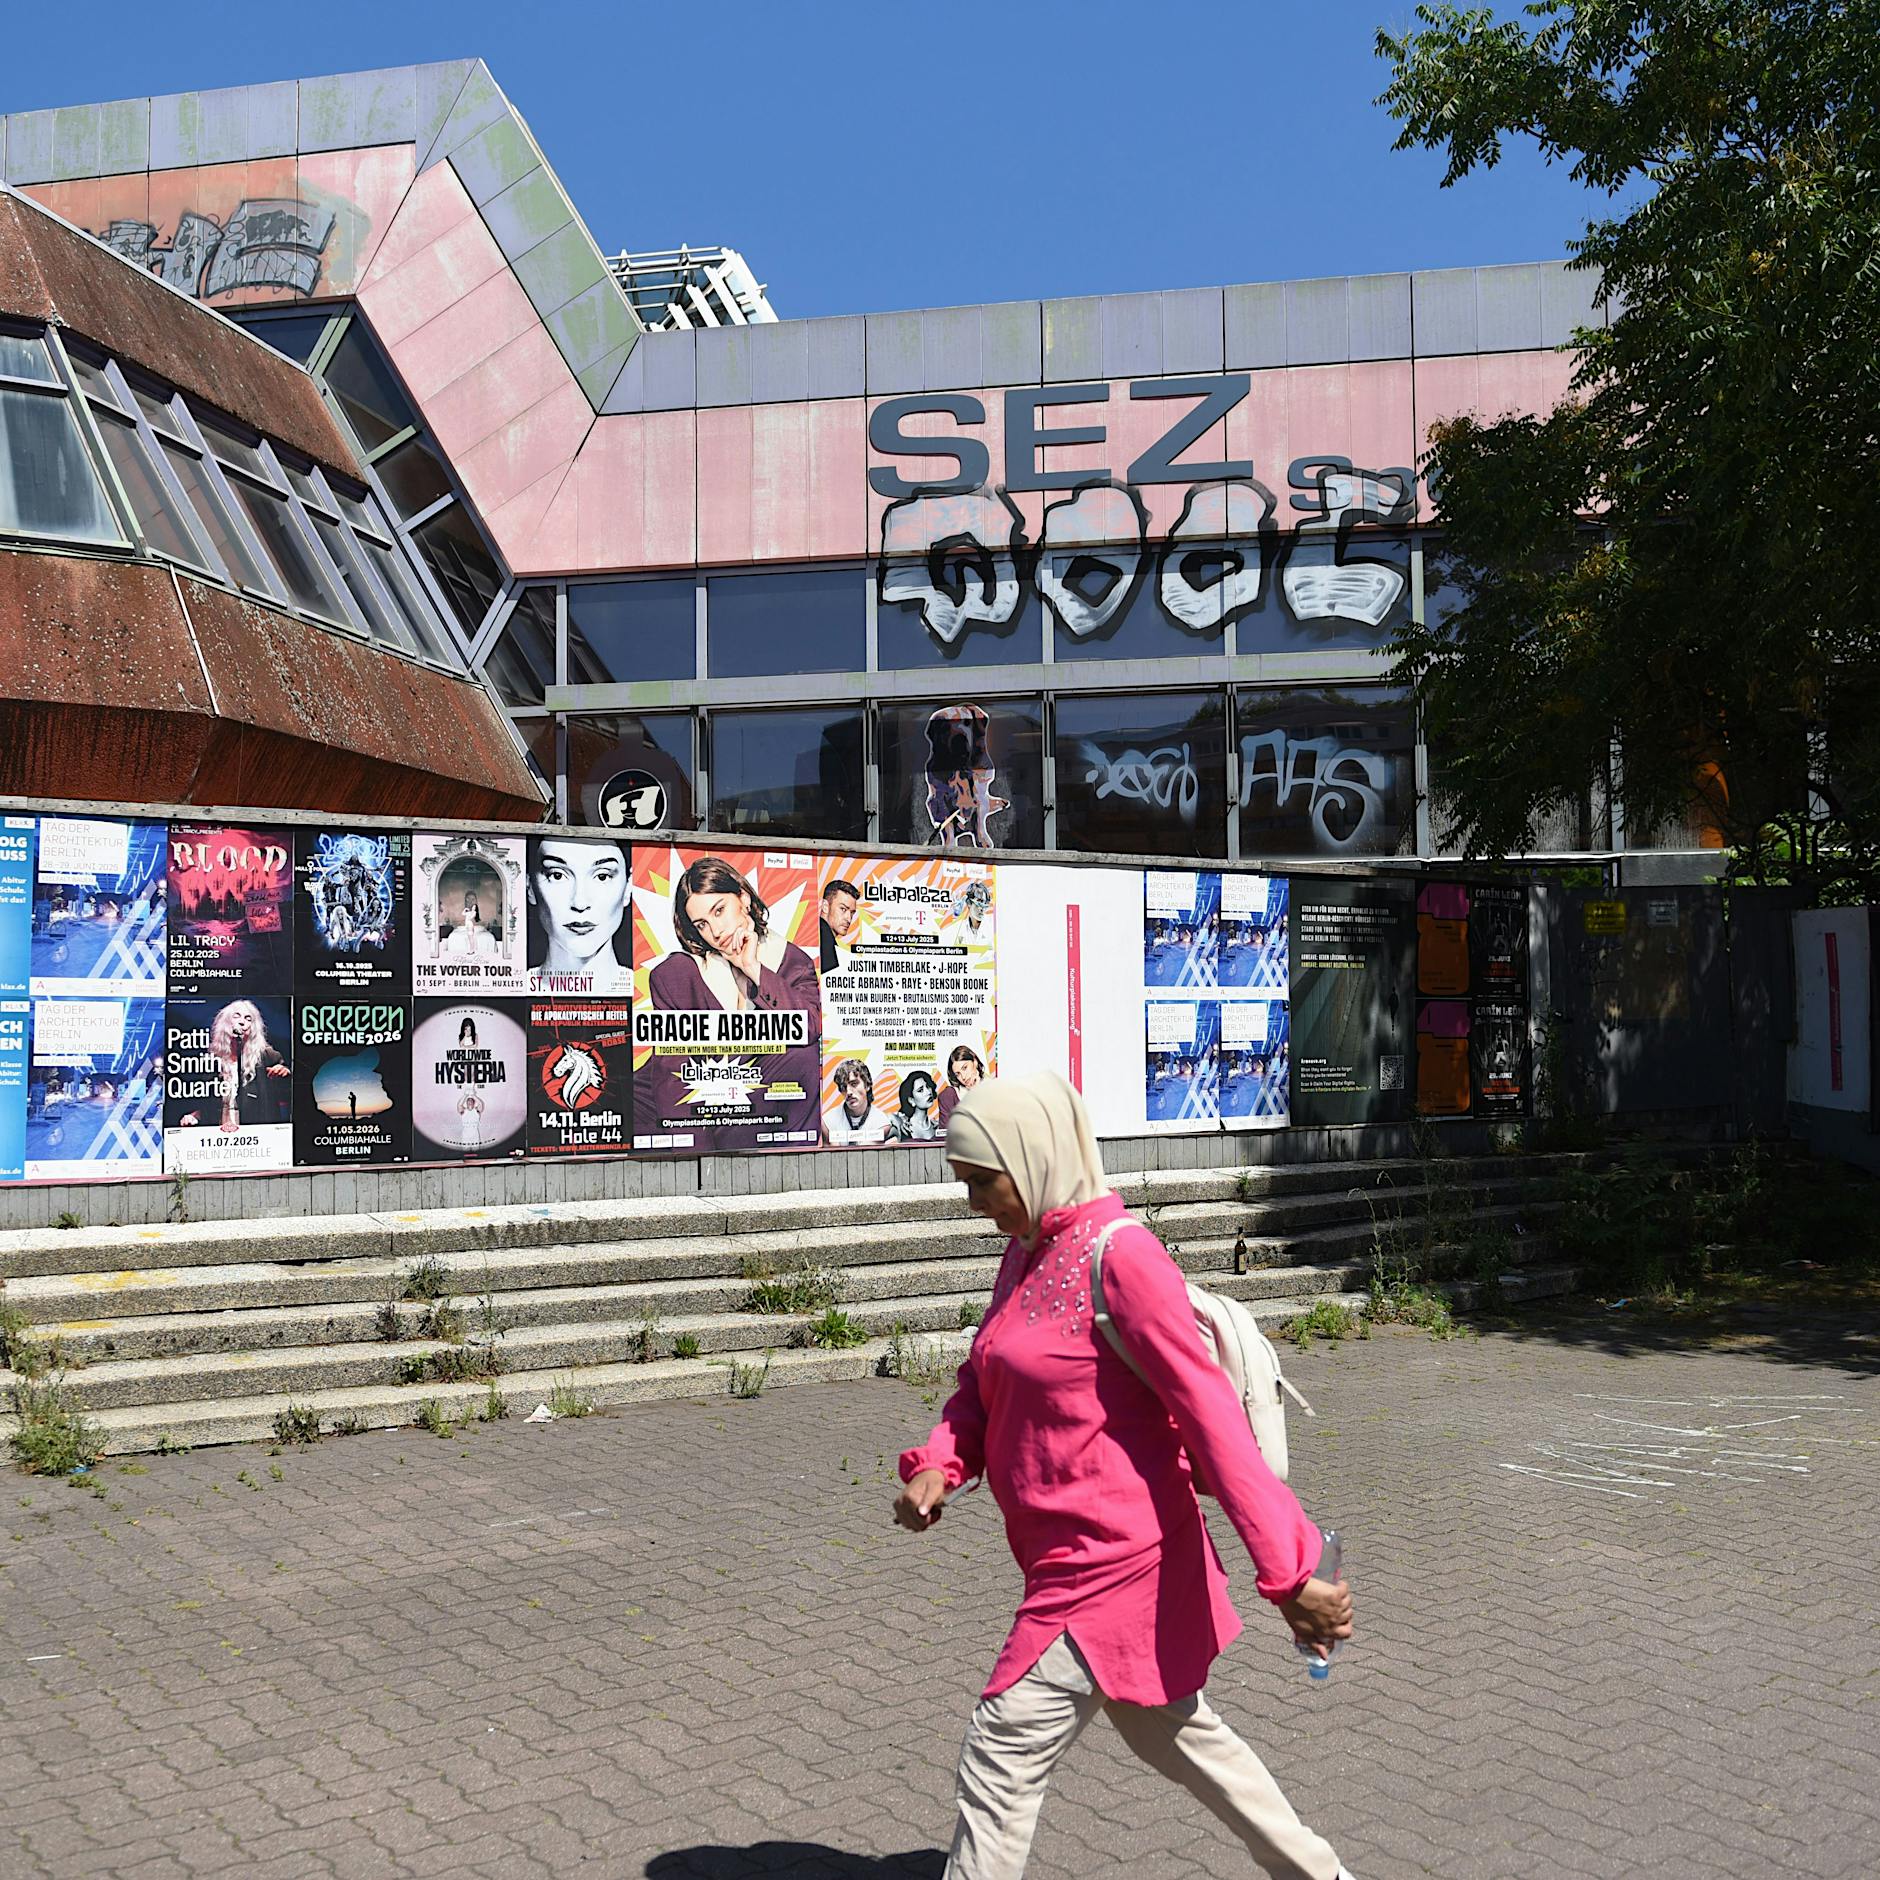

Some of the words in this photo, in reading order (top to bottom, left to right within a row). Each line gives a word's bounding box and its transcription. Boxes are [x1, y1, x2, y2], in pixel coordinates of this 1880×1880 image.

[869, 373, 1254, 499] SEZ
[46, 822, 68, 832] TAG
[69, 823, 91, 833] DER
[44, 834, 124, 847] ARCHITEKTUR
[43, 847, 86, 857] BERLIN
[169, 841, 287, 873] BLOOD
[170, 935, 190, 946] LIL
[194, 935, 236, 947] TRACY
[906, 936, 919, 944] July
[170, 950, 220, 959] 25.10.2025
[856, 946, 903, 954] Olympiastadion
[908, 947, 945, 955] Olympiapark
[170, 960, 203, 968] BERLIN
[848, 961, 877, 973] JUSTIN
[880, 961, 931, 973] TIMBERLAKE
[938, 962, 968, 974] J-HOPE
[170, 969, 242, 978] COLUMBIAHALLE
[315, 970, 355, 978] COLUMBIA
[356, 970, 393, 978] THEATER
[416, 965, 437, 976] THE
[440, 965, 481, 976] VOYEUR
[483, 965, 512, 976] TOUR
[530, 976, 546, 992] ST.
[549, 976, 594, 992] VINCENT
[825, 976, 856, 989] GRACIE
[858, 977, 894, 989] ABRAMS
[901, 977, 922, 990] RAYE
[929, 978, 961, 990] BENSON
[963, 978, 989, 991] BOONE
[830, 992, 853, 1003] ARMIN
[854, 993, 869, 1003] VAN
[870, 993, 896, 1003] BUUREN
[903, 993, 949, 1003] BRUTALISMUS
[950, 994, 968, 1003] 3000
[974, 994, 985, 1004] IVE
[40, 1004, 61, 1015] TAG
[63, 1004, 86, 1015] DER
[837, 1006, 847, 1015] THE
[848, 1006, 861, 1015] LAST
[862, 1006, 882, 1015] DINNER
[883, 1006, 900, 1015] PARTY
[906, 1007, 919, 1015] DOM
[920, 1007, 937, 1015] DOLLA
[943, 1007, 957, 1015] JOHN
[958, 1007, 980, 1015] SUMMIT
[531, 1011, 542, 1020] DIE
[543, 1011, 604, 1020] APOKALYPTISCHEN
[605, 1011, 628, 1020] REITER
[38, 1017, 120, 1027] ARCHITEKTUR
[636, 1013, 710, 1042] GRACIE
[718, 1013, 804, 1041] ABRAMS
[842, 1018, 868, 1026] ARTEMAS
[875, 1018, 906, 1026] SHABOOZEY
[911, 1018, 928, 1026] ROYEL
[929, 1018, 941, 1026] OTIS
[946, 1018, 973, 1026] ASHNIKKO
[38, 1029, 82, 1039] BERLIN
[167, 1028, 210, 1049] Patti
[862, 1029, 895, 1037] MAGDALENA
[896, 1029, 907, 1037] BAY
[913, 1029, 935, 1037] MOTHER
[936, 1029, 959, 1037] MOTHER
[659, 1046, 686, 1054] TOGETHER
[687, 1046, 700, 1054] WITH
[764, 1045, 775, 1053] LIVE
[884, 1042, 897, 1050] AND
[898, 1042, 917, 1050] MANY
[917, 1042, 935, 1050] MORE
[446, 1049, 492, 1061] WORLDWIDE
[167, 1053, 222, 1074] Smith
[435, 1061, 506, 1084] HYSTERIA
[719, 1106, 733, 1116] July
[734, 1105, 750, 1113] 2025
[539, 1112, 578, 1128] 14.11.
[579, 1111, 622, 1127] Berlin
[663, 1119, 715, 1128] Olympiastadion
[722, 1117, 763, 1127] Olympiapark
[764, 1116, 782, 1124] Berlin
[327, 1125, 380, 1134] 11.05.2026
[314, 1135, 391, 1145] COLUMBIAHALLE
[561, 1128, 597, 1144] Hole
[602, 1127, 622, 1143] 44
[200, 1136, 259, 1147] 11.07.2025
[187, 1149, 221, 1160] BERLIN
[223, 1147, 272, 1159] ZITADELLE
[335, 1146, 371, 1155] BERLIN
